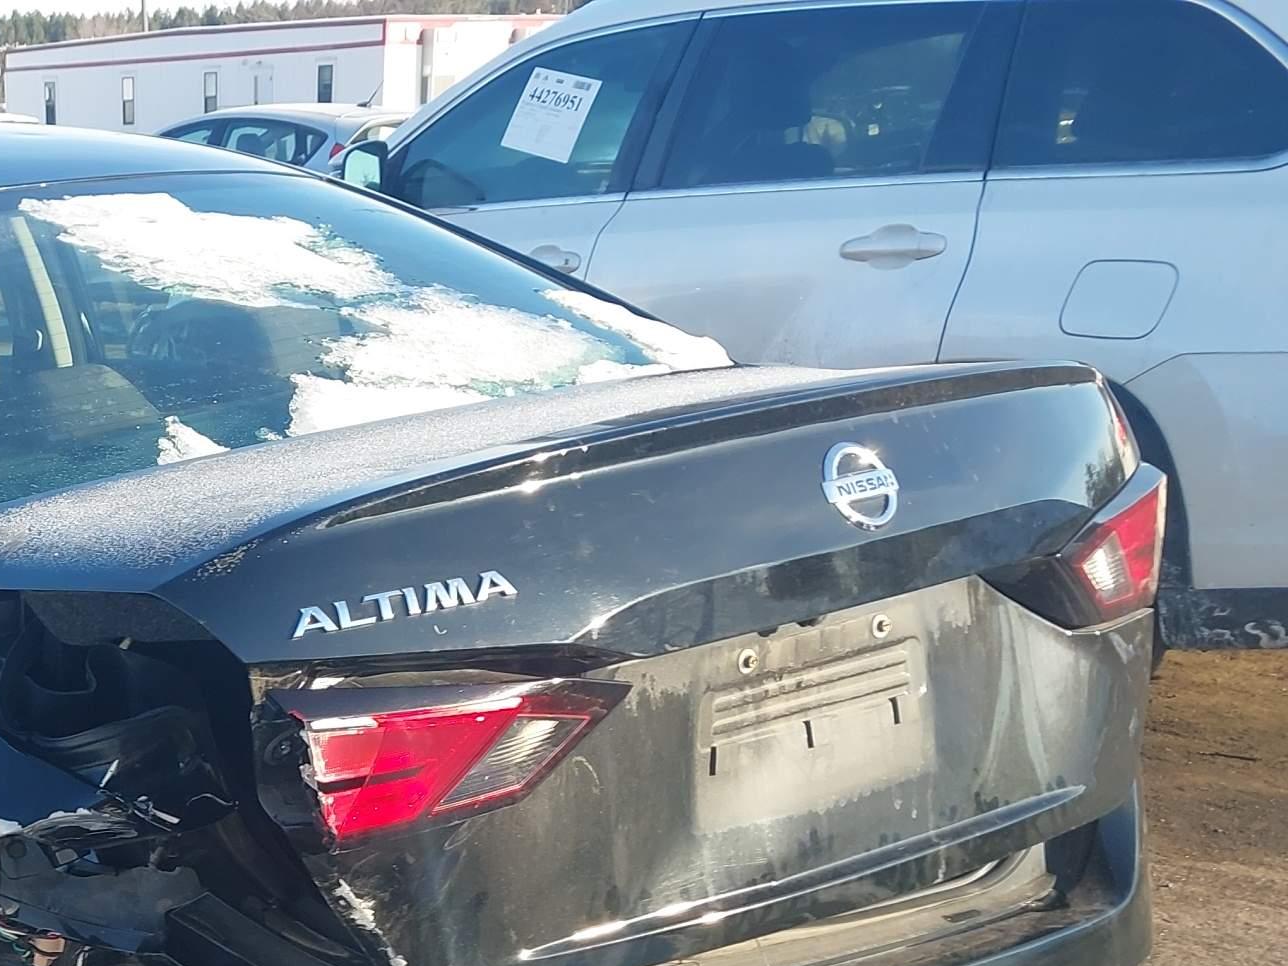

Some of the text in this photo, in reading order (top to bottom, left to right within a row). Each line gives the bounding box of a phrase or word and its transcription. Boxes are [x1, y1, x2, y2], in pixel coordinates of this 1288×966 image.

[529, 87, 583, 111] 44276951
[836, 473, 895, 497] NISSAN
[291, 568, 519, 640] ALTIMA
